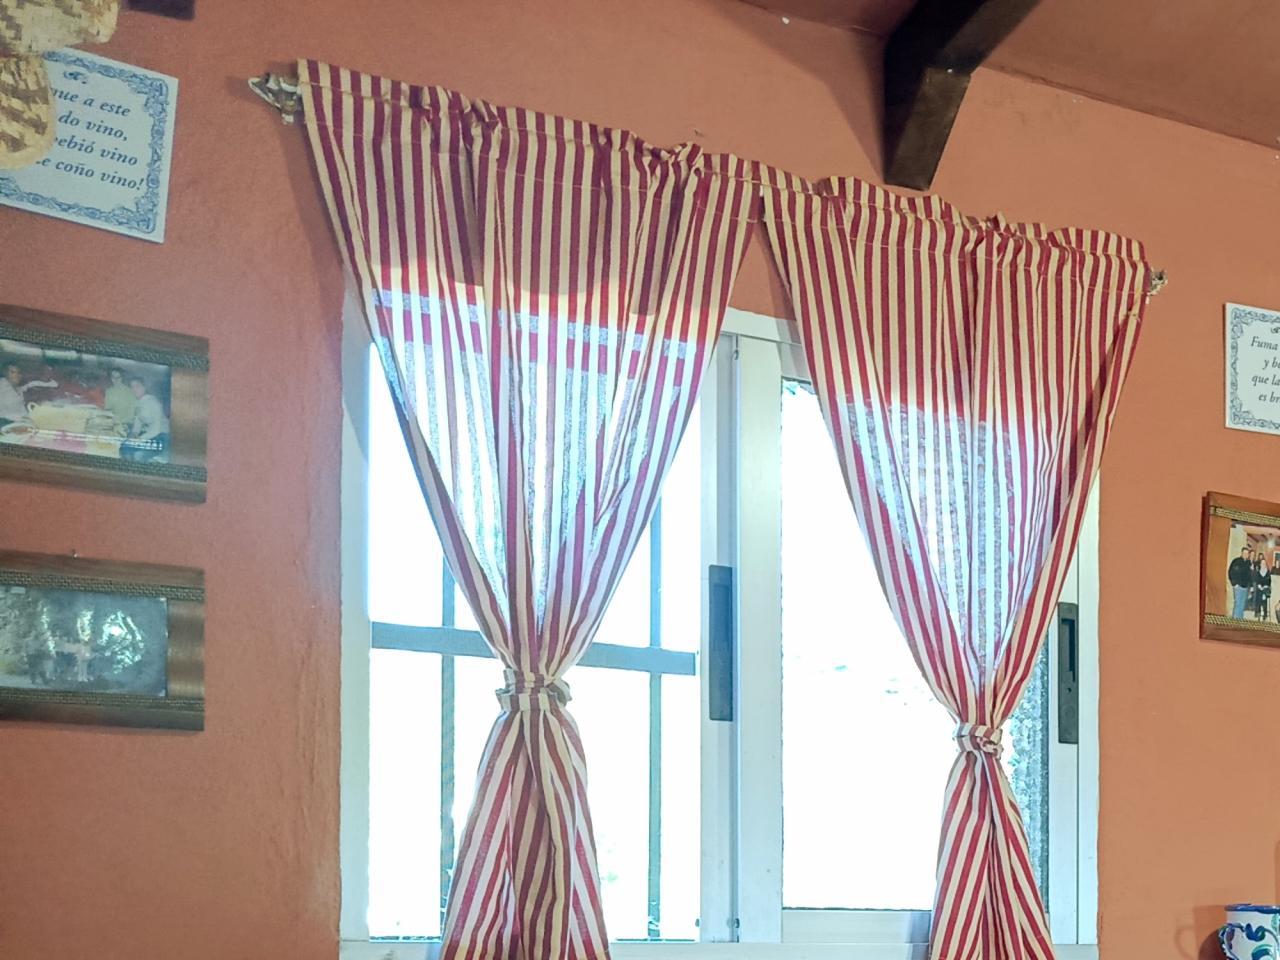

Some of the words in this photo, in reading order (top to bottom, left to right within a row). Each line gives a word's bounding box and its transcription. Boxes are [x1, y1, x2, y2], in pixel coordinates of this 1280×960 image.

[83, 97, 94, 107] a
[100, 101, 131, 117] este
[86, 120, 128, 142] vino,
[55, 135, 95, 154] ebió
[100, 147, 138, 166] vino
[55, 161, 94, 178] coño
[100, 171, 144, 191] vino!
[1251, 336, 1278, 351] Fuma
[1262, 359, 1270, 370] y
[1251, 375, 1270, 387] que
[1271, 374, 1280, 386] la
[1258, 394, 1268, 402] es
